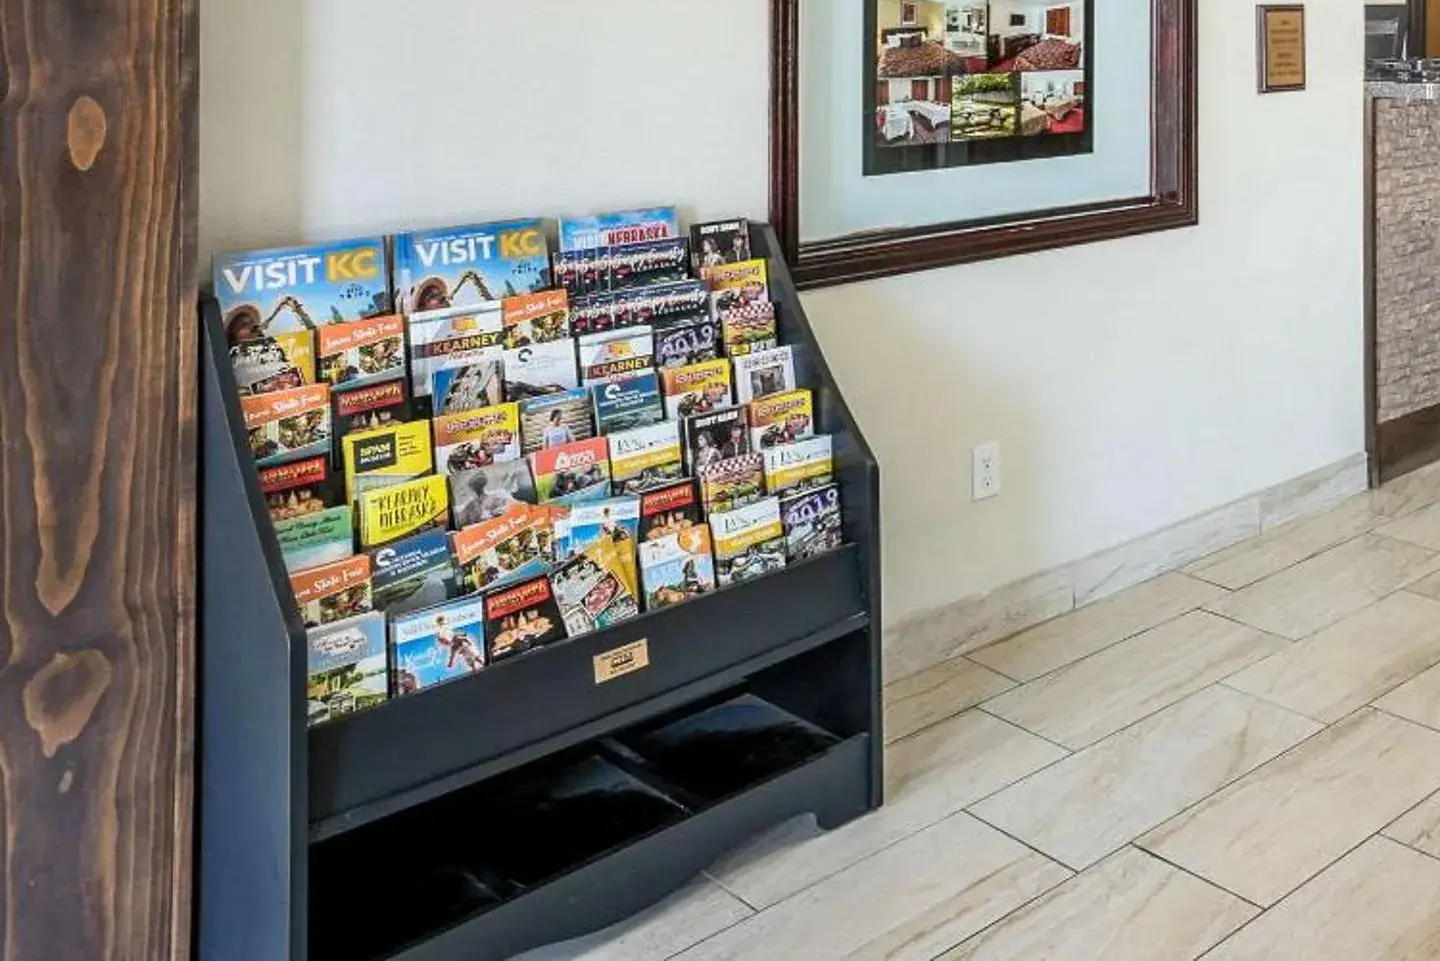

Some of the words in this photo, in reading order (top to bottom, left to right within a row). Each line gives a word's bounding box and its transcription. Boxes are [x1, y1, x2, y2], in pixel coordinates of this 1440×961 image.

[414, 235, 496, 267] VISIT
[500, 229, 541, 259] KC
[222, 256, 321, 294] VISIT
[327, 248, 379, 282] KC
[431, 334, 498, 355] KEARNEY
[592, 357, 650, 377] KEARNEY
